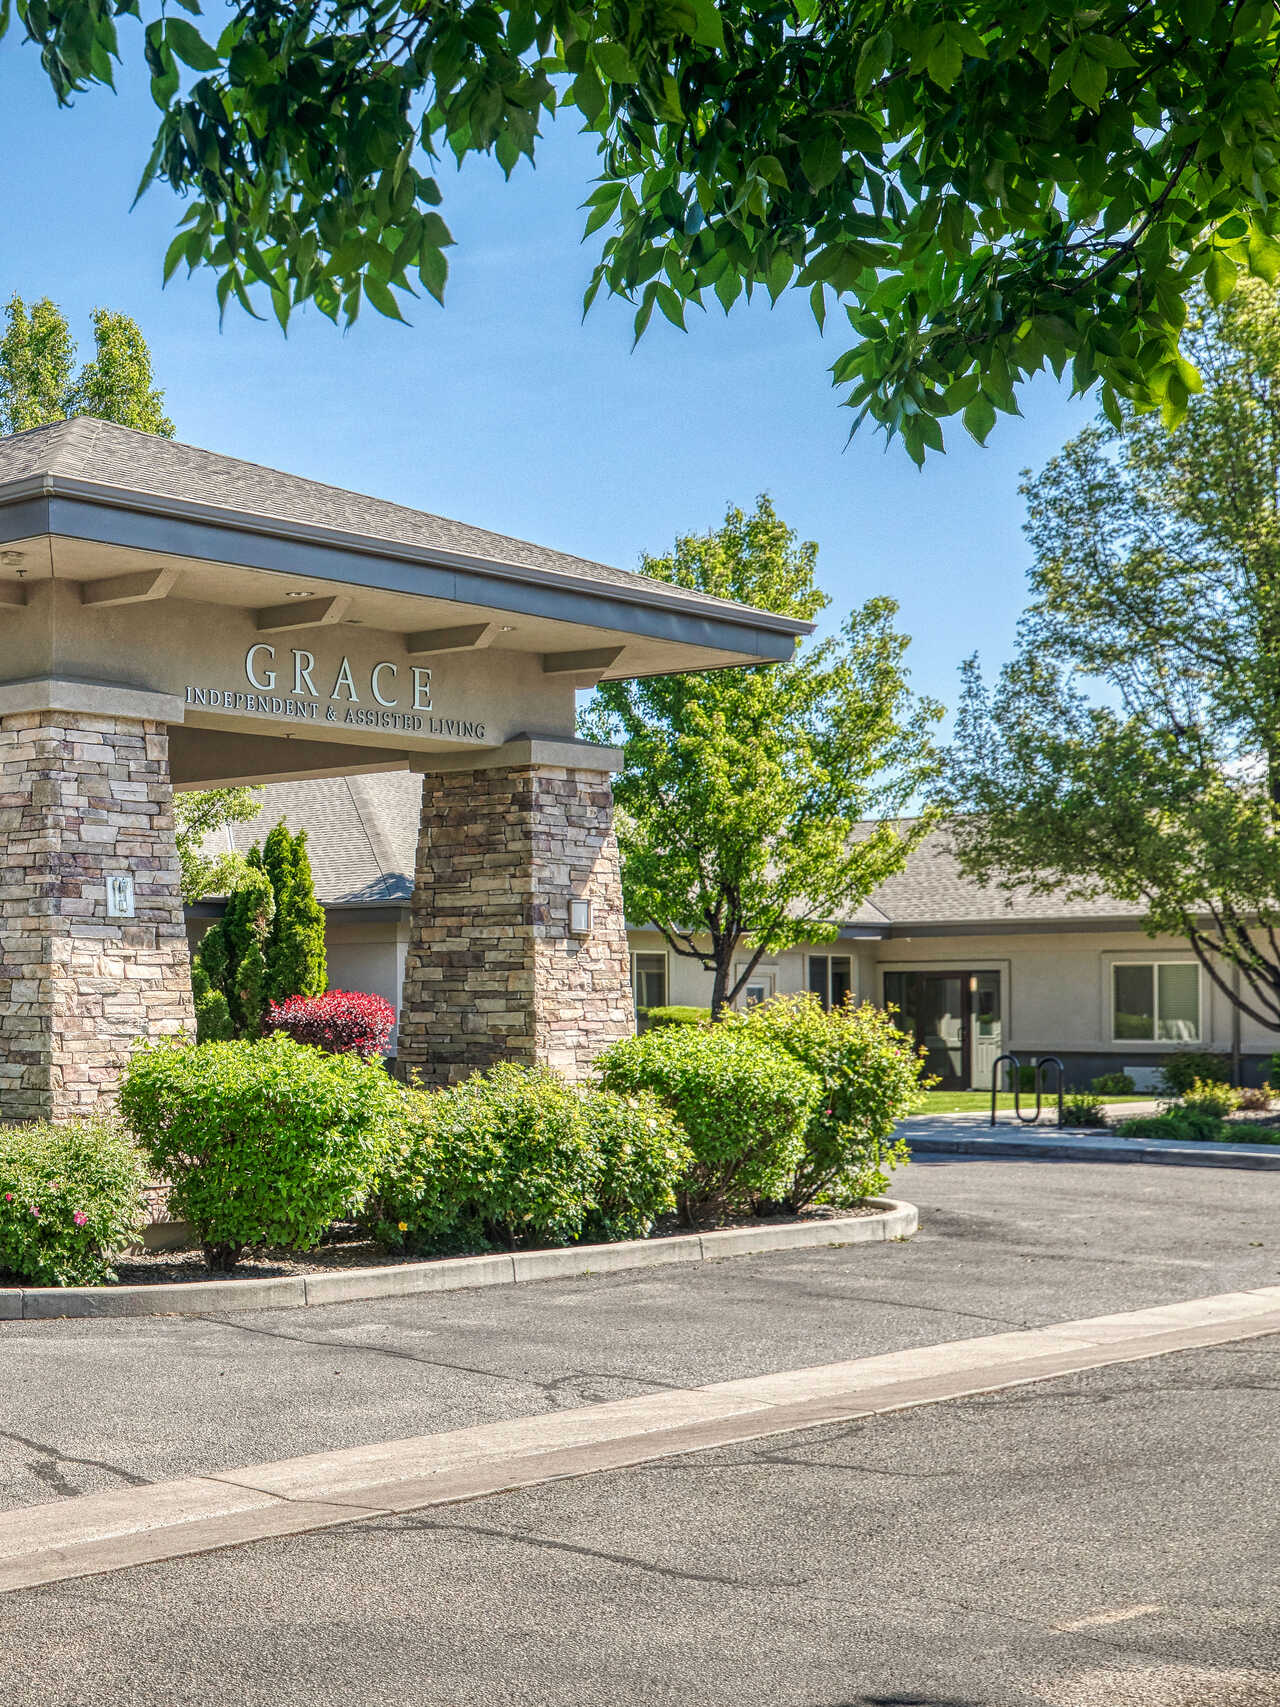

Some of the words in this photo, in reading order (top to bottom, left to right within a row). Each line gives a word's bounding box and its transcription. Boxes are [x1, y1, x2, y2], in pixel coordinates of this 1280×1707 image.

[245, 643, 433, 711] GRACE
[185, 686, 319, 719] INDEPENDENT
[326, 704, 337, 721] &
[344, 707, 422, 731] ASSISTED
[430, 717, 486, 739] LIVING
